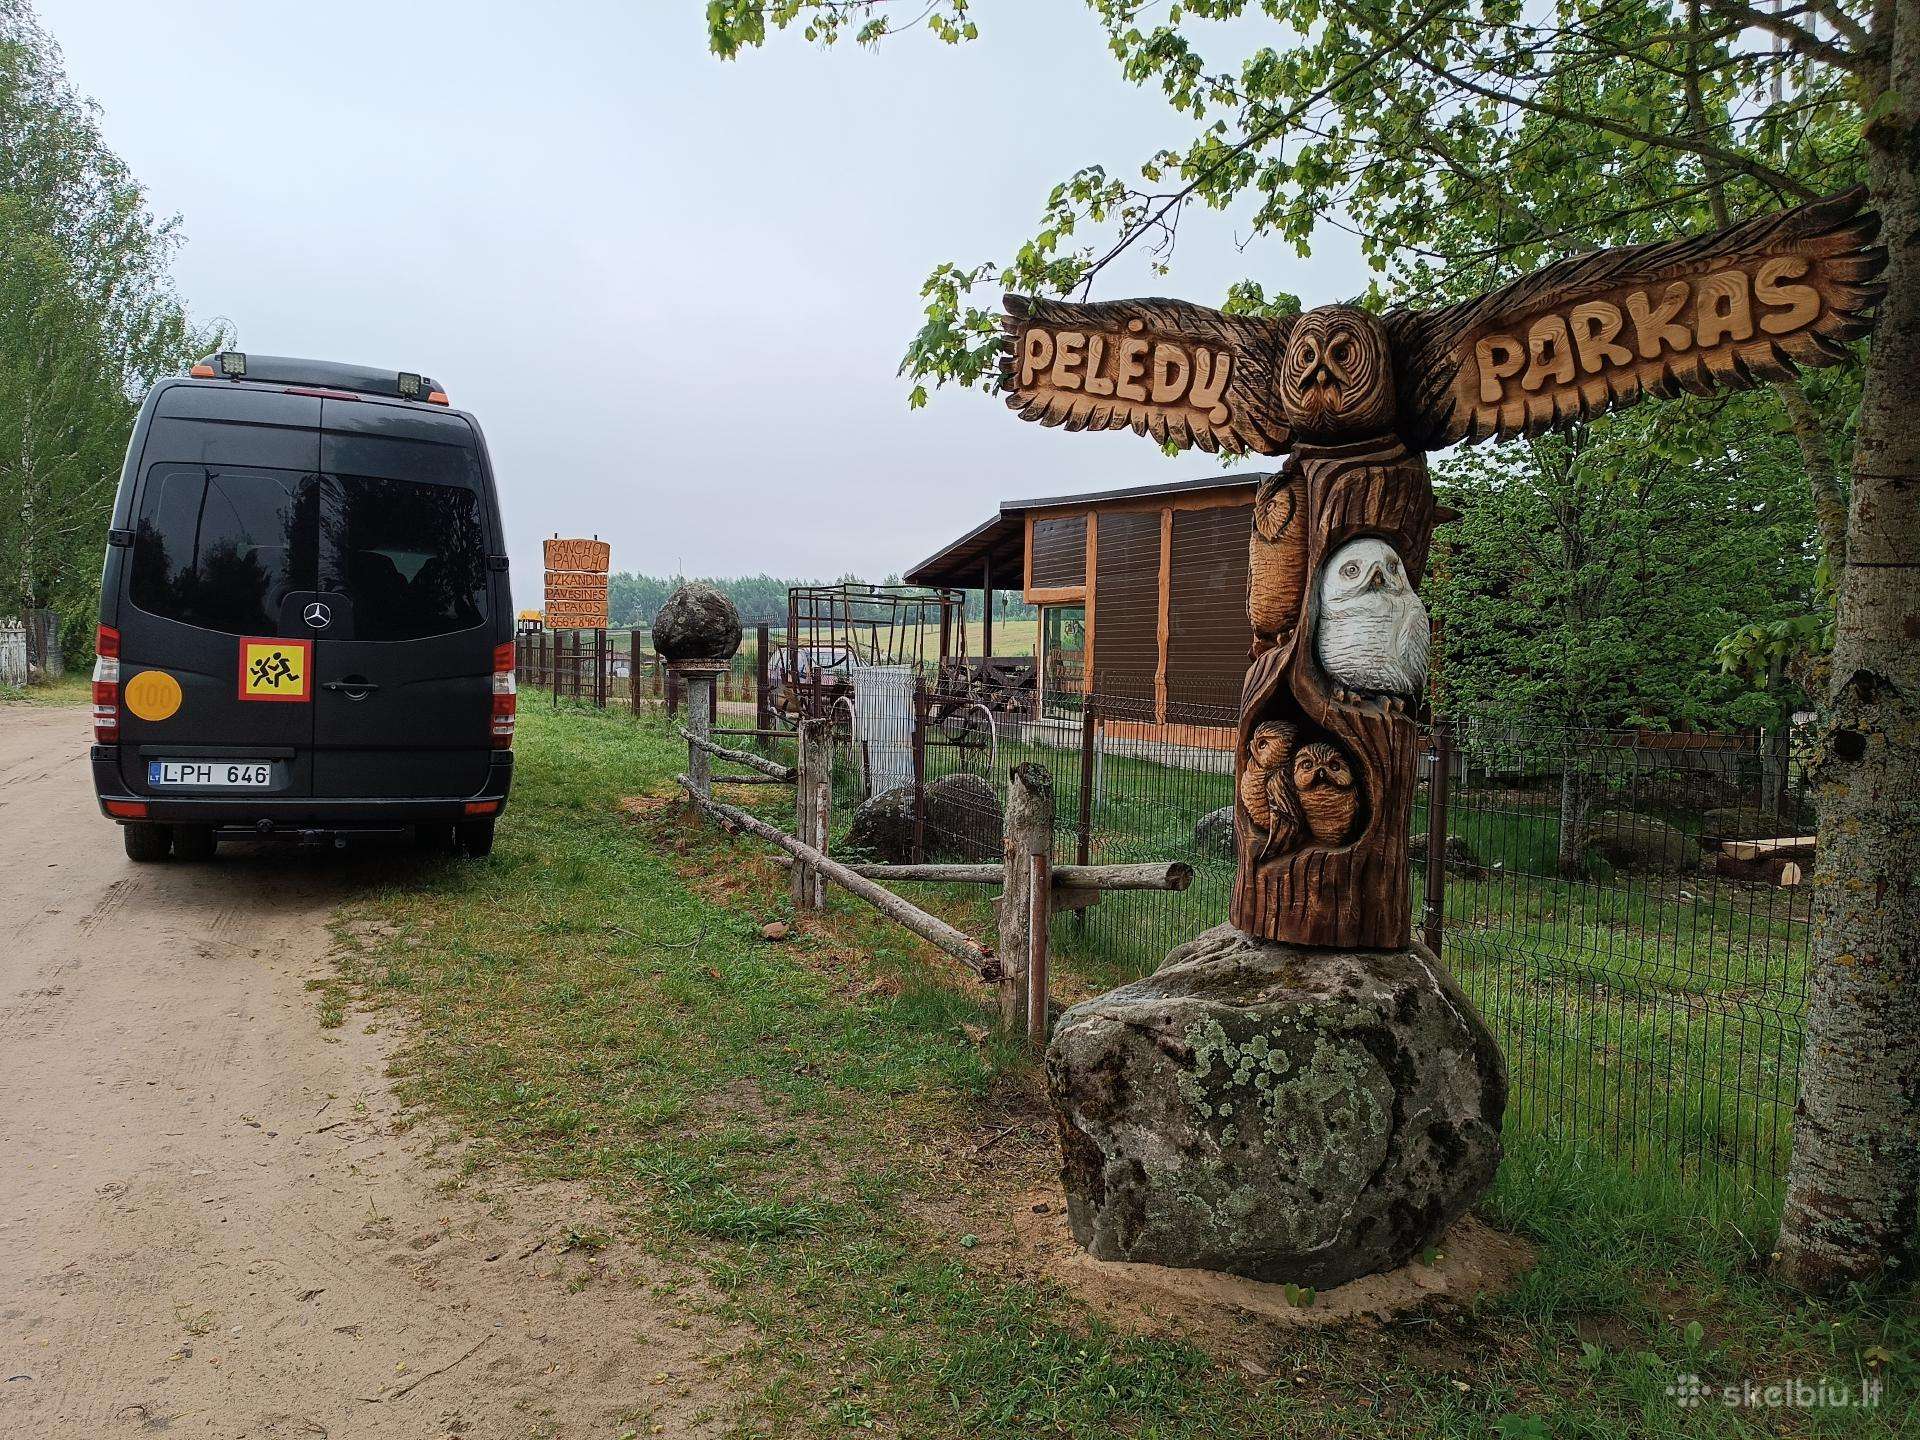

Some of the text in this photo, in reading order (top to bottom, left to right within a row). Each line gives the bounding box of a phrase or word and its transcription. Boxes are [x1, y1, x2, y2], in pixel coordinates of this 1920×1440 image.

[1021, 257, 1821, 425] PELĖDŲ PARKAS
[548, 540, 602, 556] RANCHO
[553, 553, 609, 571] PANCHO
[548, 602, 601, 613] ALPAKOS
[135, 683, 172, 708] 100
[164, 764, 267, 784] LPH 646
